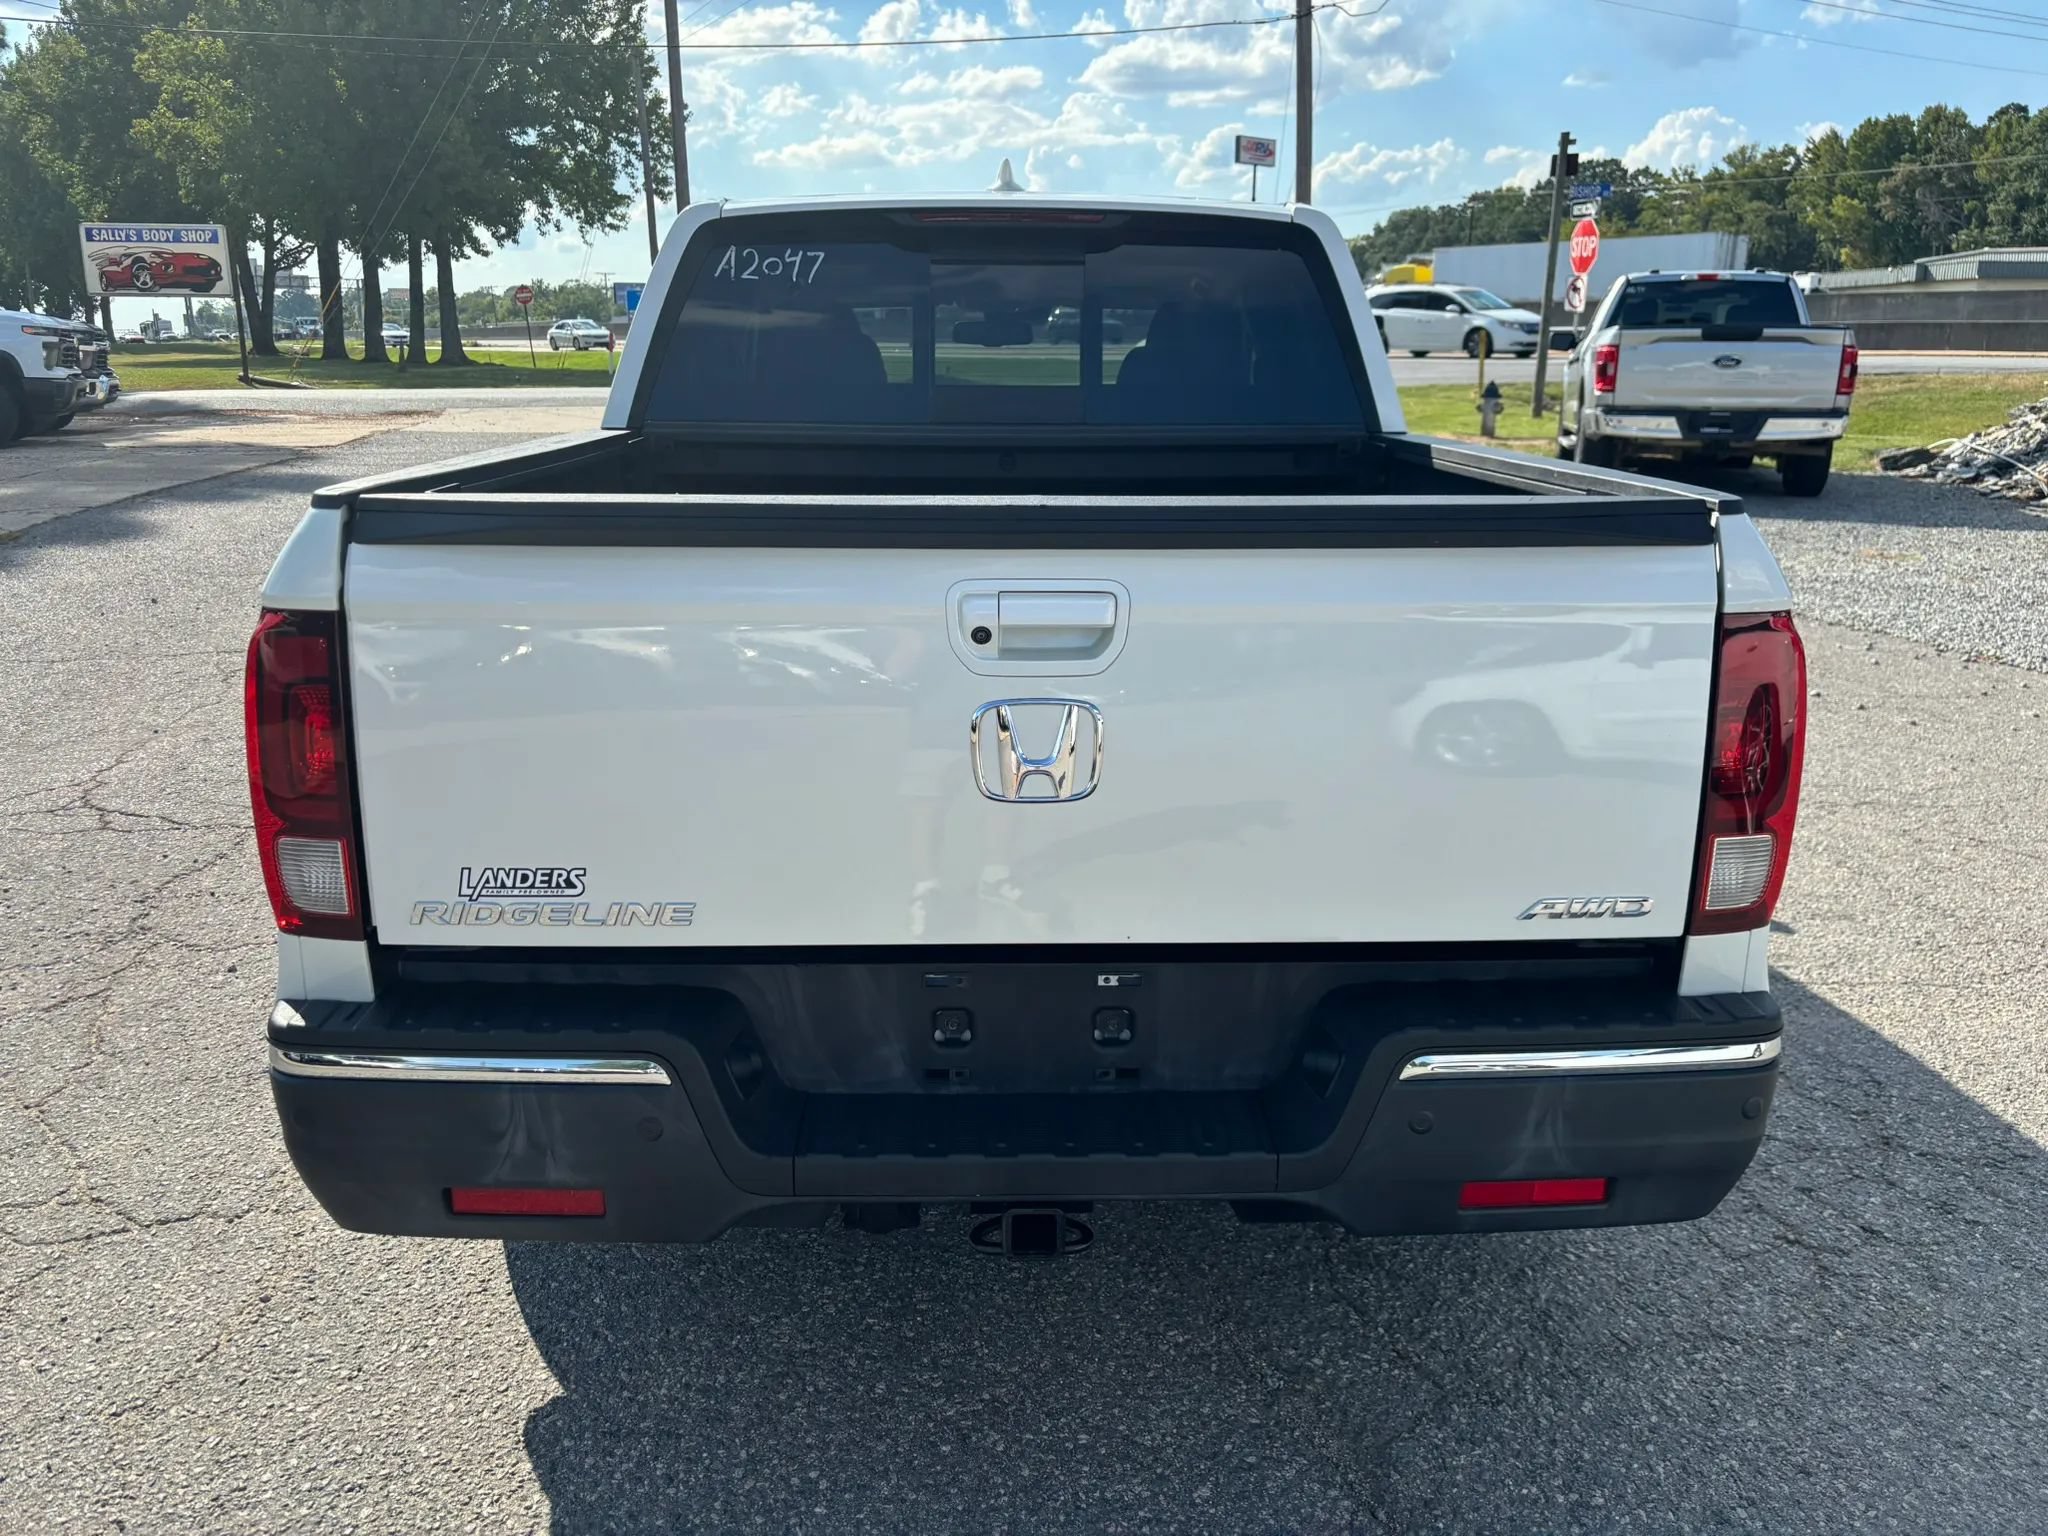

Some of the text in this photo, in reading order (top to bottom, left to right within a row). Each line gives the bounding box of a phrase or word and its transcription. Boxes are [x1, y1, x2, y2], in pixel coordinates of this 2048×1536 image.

[92, 229, 213, 243] SALLY'S BODY SHOP
[1571, 235, 1597, 258] STOP
[714, 244, 825, 284] A2047
[459, 867, 586, 901] LANDERS
[409, 900, 697, 926] RIDGELINE
[1515, 896, 1654, 920] AWD
